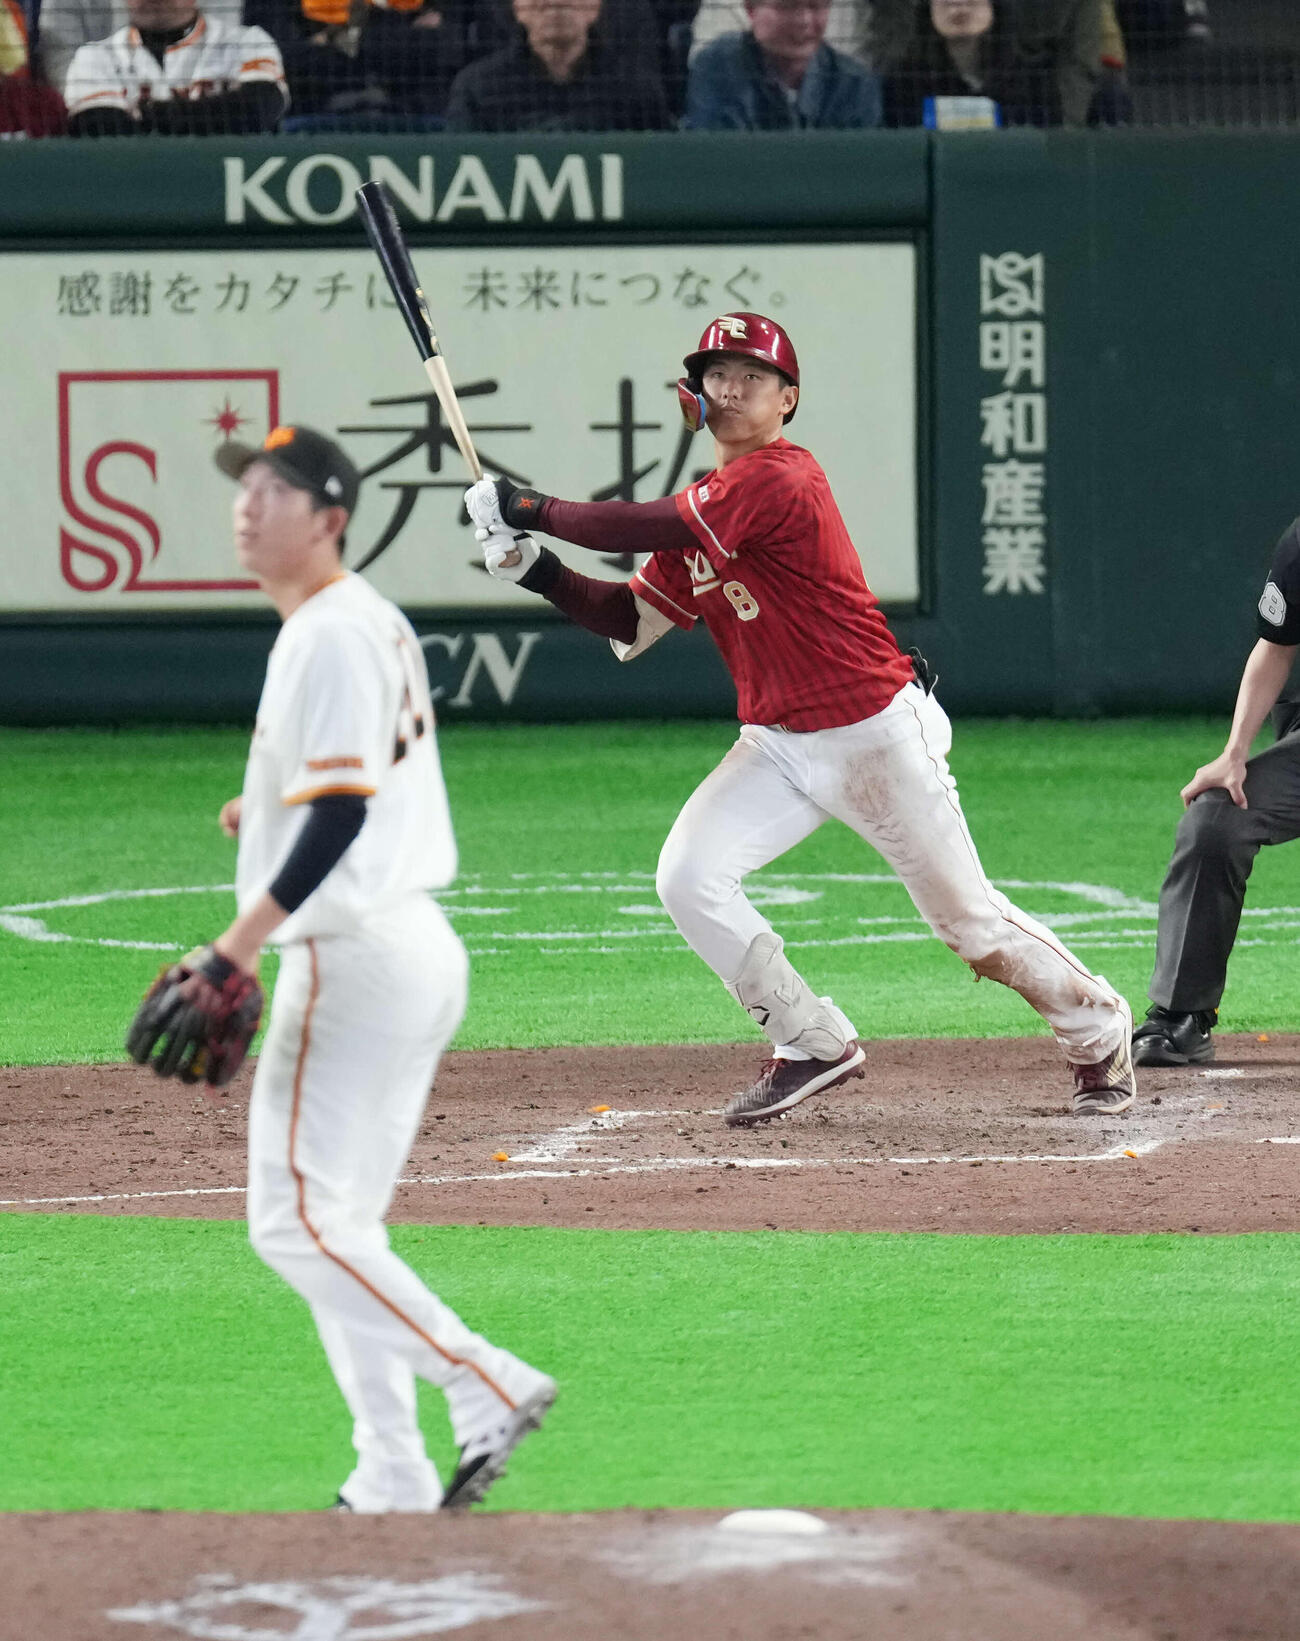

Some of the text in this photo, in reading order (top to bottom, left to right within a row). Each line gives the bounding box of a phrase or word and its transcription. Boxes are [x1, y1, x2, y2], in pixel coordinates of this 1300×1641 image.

[224, 154, 624, 224] KONAMI
[464, 266, 787, 312] 未来につなぐ。
[979, 321, 1047, 595] 明和産業
[723, 581, 759, 621] 8
